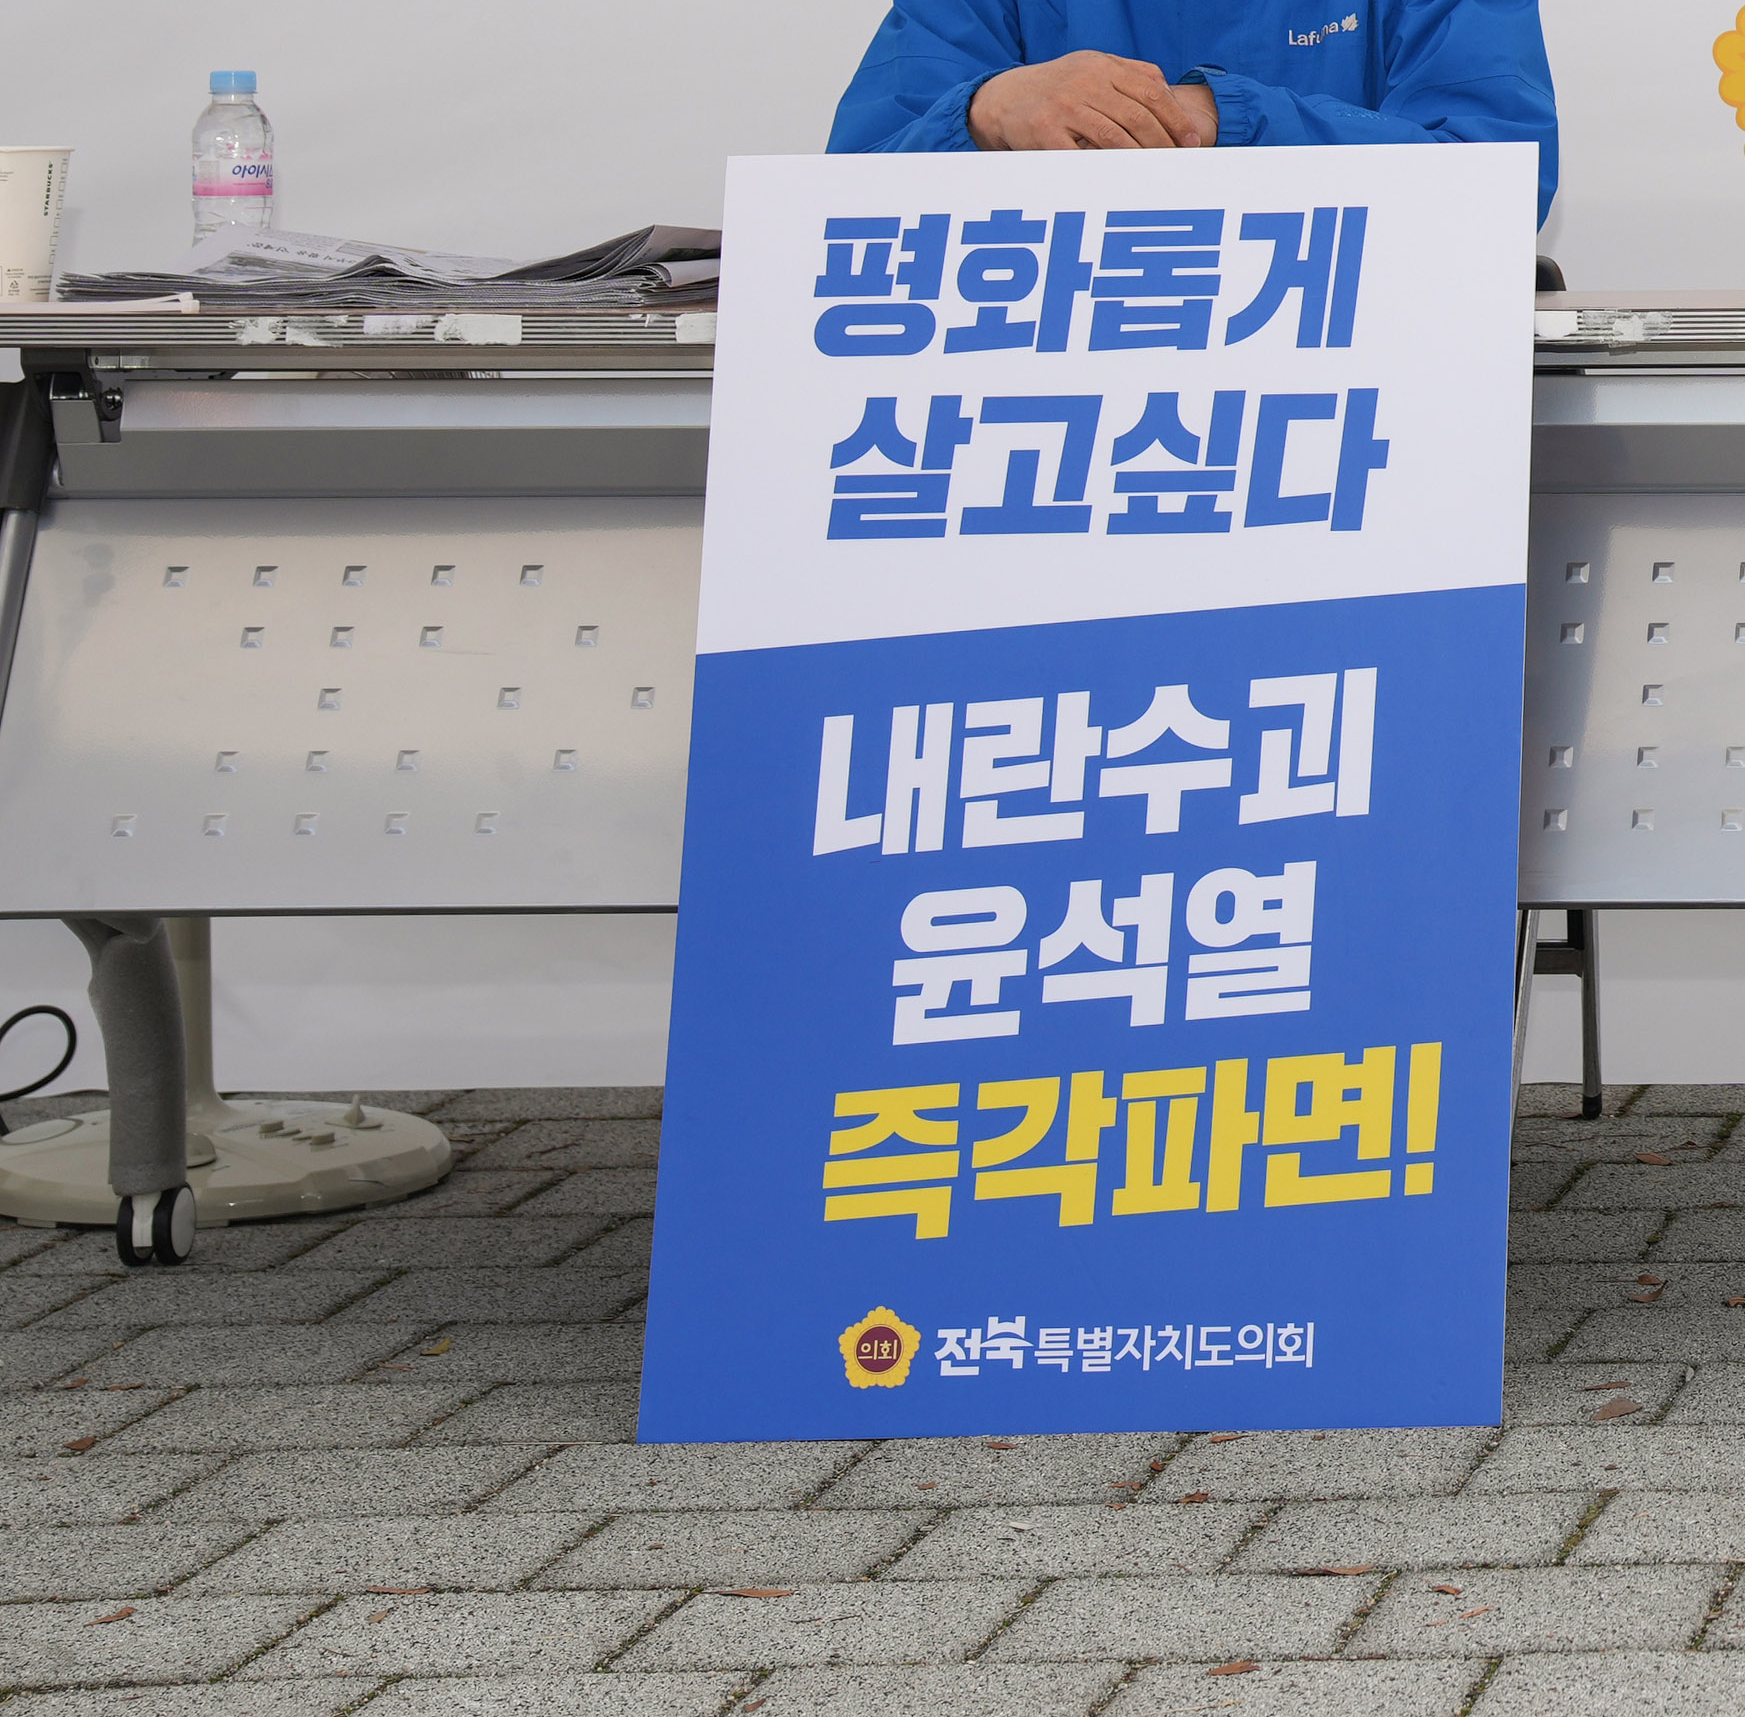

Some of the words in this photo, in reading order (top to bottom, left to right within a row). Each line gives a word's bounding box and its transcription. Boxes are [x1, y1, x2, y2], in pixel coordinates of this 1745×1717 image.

[43, 162, 54, 217] STARBUCKS
[815, 207, 1368, 357] 평화롭게
[828, 388, 1389, 541] 살고싶다
[813, 667, 1378, 856] 내란수괴
[893, 860, 1317, 1046] 윤석열
[824, 1041, 1442, 1240] 즉각파면!
[859, 1340, 898, 1364] 의회
[935, 1316, 1315, 1376] 전북특별자치도의회
